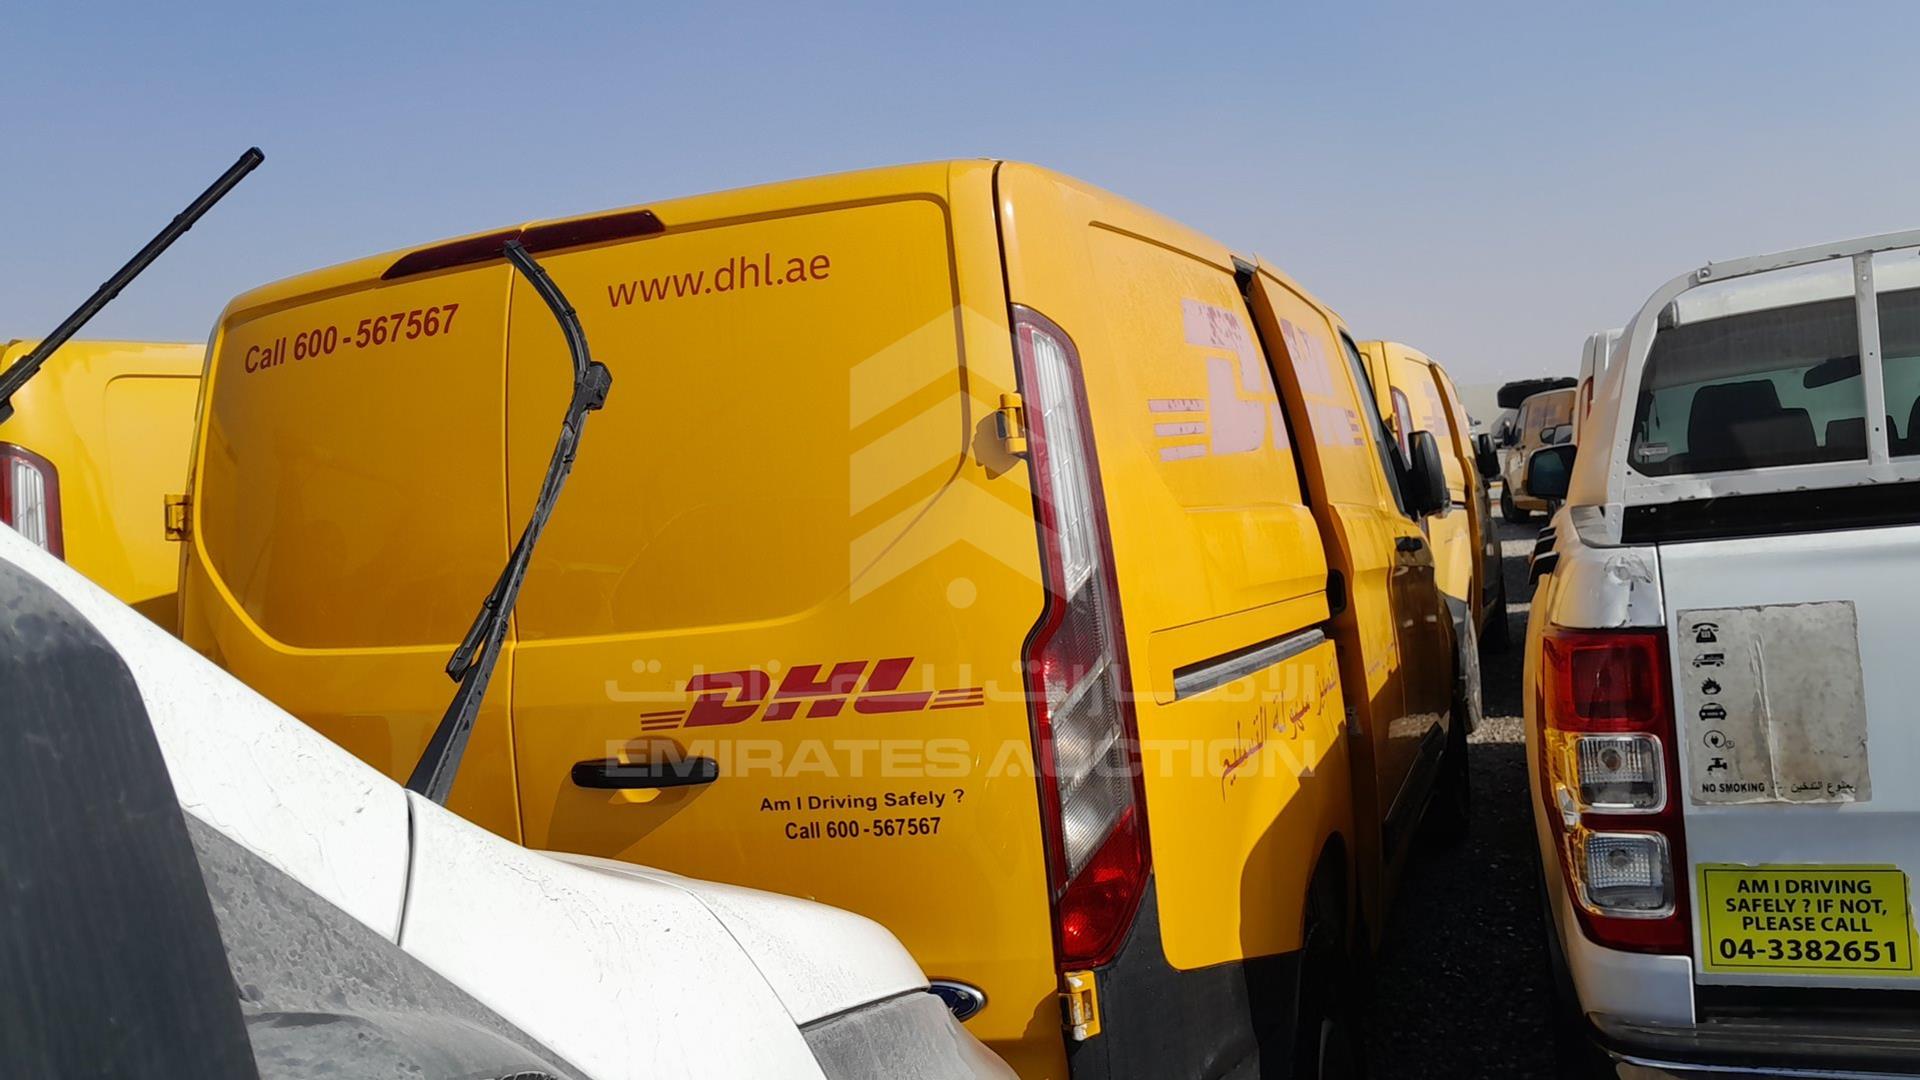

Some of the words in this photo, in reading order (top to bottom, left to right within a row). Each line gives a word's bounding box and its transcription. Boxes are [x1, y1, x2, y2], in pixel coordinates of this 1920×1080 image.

[607, 254, 830, 308] www.dhl.ae
[244, 334, 287, 374] Call
[683, 657, 933, 728] DHL
[1702, 783, 1717, 793] NO
[1719, 782, 1766, 793] SMOKING
[760, 797, 791, 812] Am
[797, 796, 802, 811] I
[808, 795, 878, 812] Driving
[884, 790, 946, 809] Safely
[785, 821, 821, 840] Call
[1738, 879, 1769, 894] AM
[1774, 879, 1780, 894] I
[1786, 879, 1872, 895] DRIVING
[1725, 898, 1797, 913] SAFELY
[1816, 899, 1834, 914] IF
[1840, 899, 1887, 916] NOT,
[1742, 916, 1816, 932] PLEASE
[1821, 917, 1873, 933] CALL
[1719, 938, 1897, 963] 04-3382651
